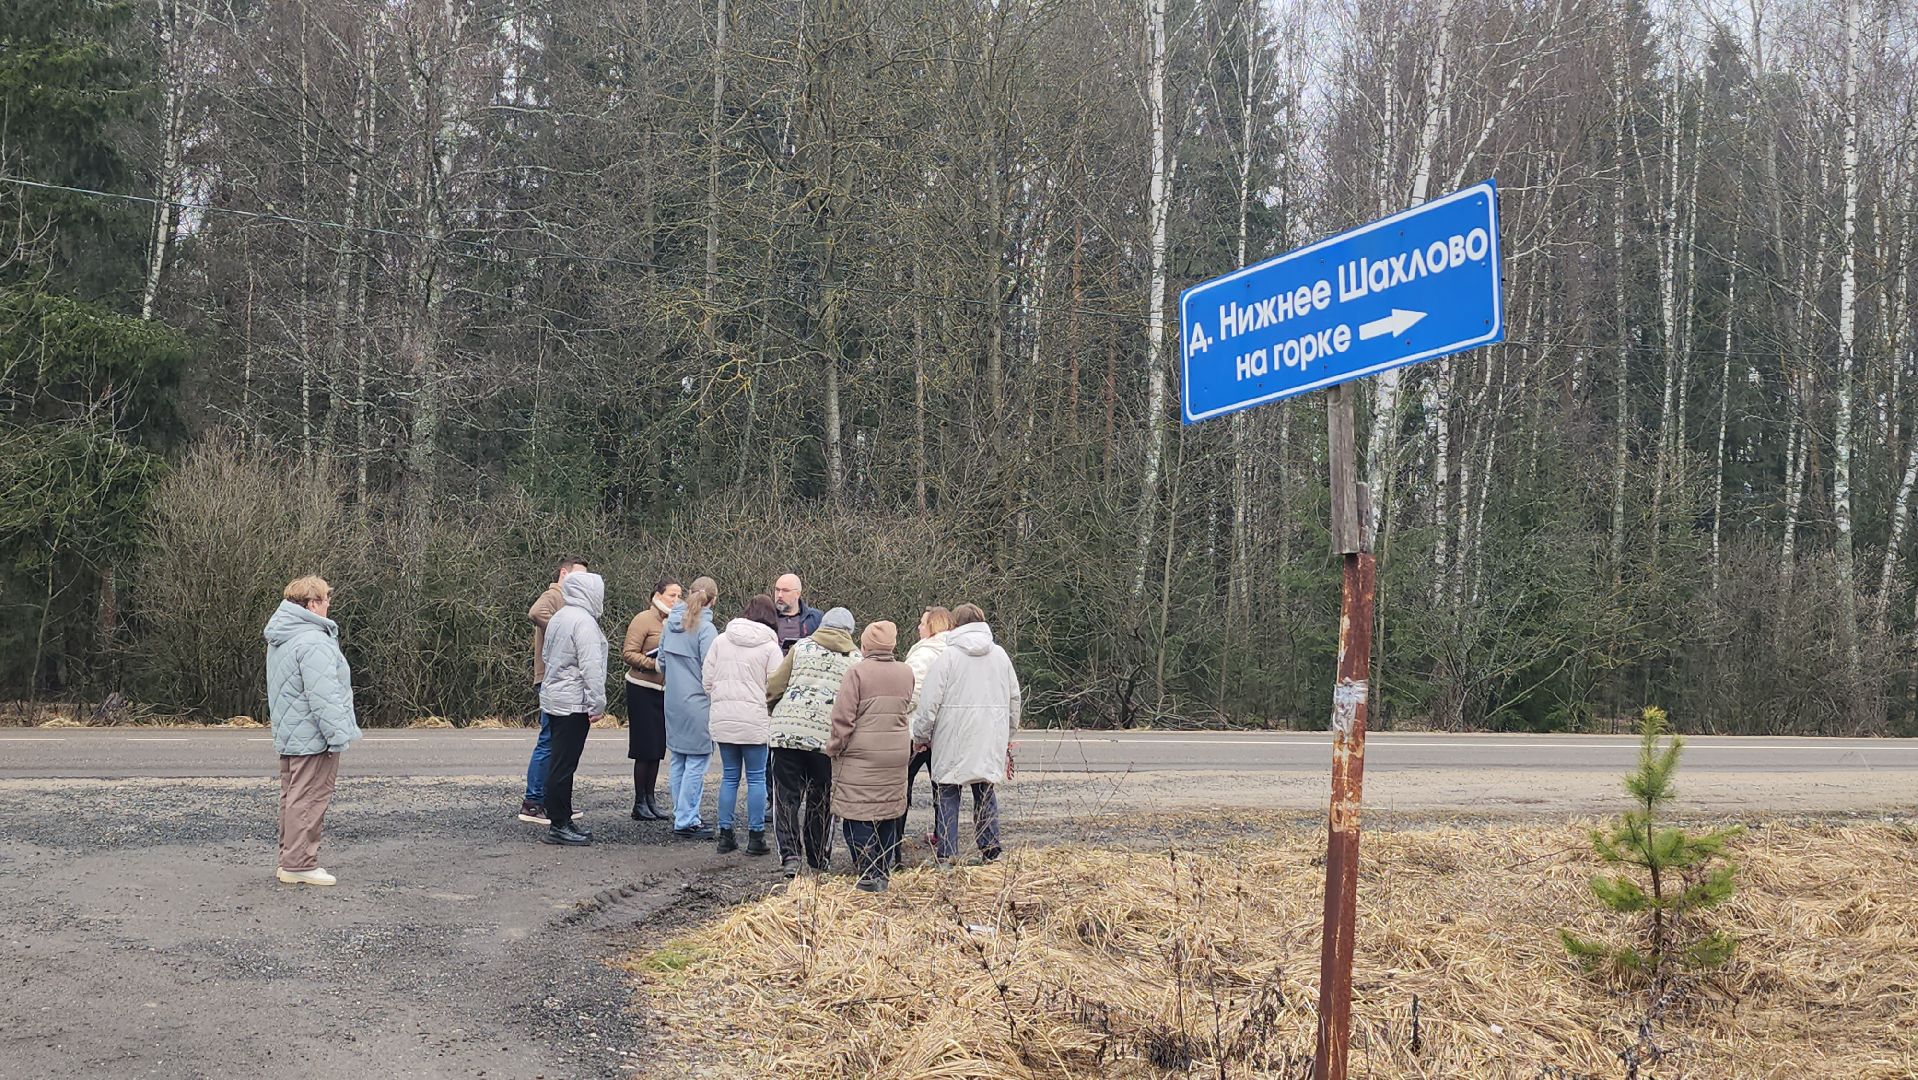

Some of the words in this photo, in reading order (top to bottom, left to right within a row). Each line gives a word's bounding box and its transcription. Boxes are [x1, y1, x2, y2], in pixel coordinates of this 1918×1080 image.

[1219, 280, 1332, 341] Нижнее
[1338, 227, 1489, 303] Шахлово
[1236, 348, 1268, 381] на
[1273, 324, 1352, 371] горке
